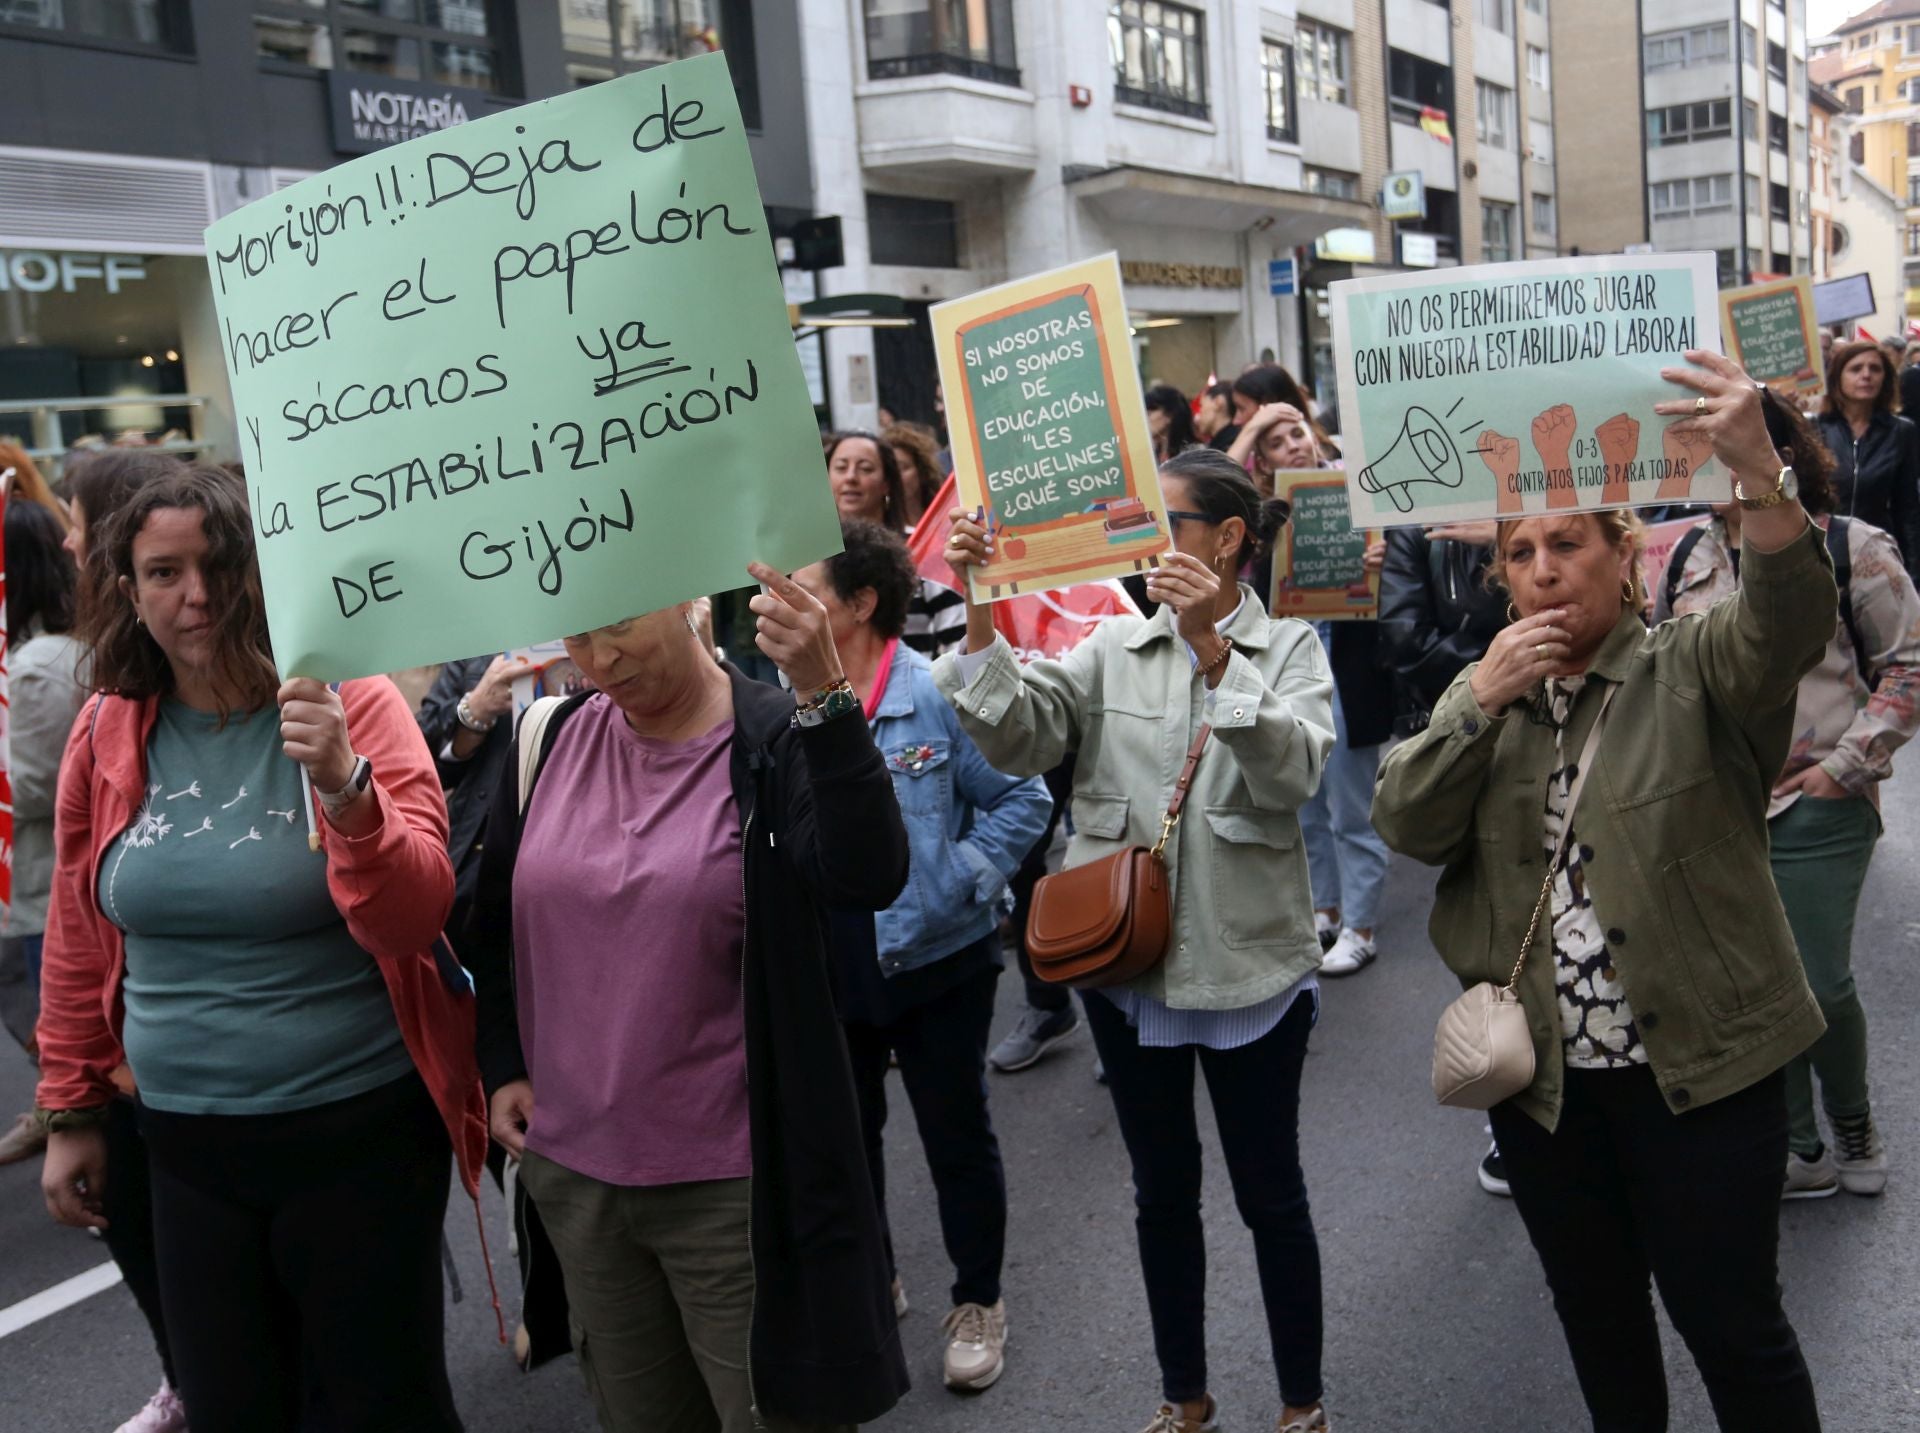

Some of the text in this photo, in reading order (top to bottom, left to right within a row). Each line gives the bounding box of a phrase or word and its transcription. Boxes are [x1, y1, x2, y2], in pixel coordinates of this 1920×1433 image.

[350, 88, 470, 128] NOTARÍA
[633, 84, 725, 152] de
[226, 182, 755, 375] hacer el papelón
[1388, 274, 1656, 337] NO OS PERMITIREMOS JUGAR
[577, 320, 671, 393] ya
[965, 311, 1092, 367] SI NOSOTRAS
[1355, 346, 1391, 386] CON
[1400, 335, 1479, 381] NUESTRA
[1486, 321, 1605, 371] ESTABILIDAD
[981, 341, 1084, 387] NO SOMOS
[1021, 377, 1051, 400] DE
[983, 391, 1105, 440] EDUCACIÓN,
[1576, 437, 1598, 458] 0-3
[1004, 467, 1120, 517] ¿QUÉ SON?
[1306, 494, 1348, 506] NOSOT
[1508, 458, 1688, 494] CONTRATOS FIJOS PARA TODAS
[1300, 509, 1316, 519] NO
[1322, 521, 1337, 531] DE
[332, 561, 403, 618] DE
